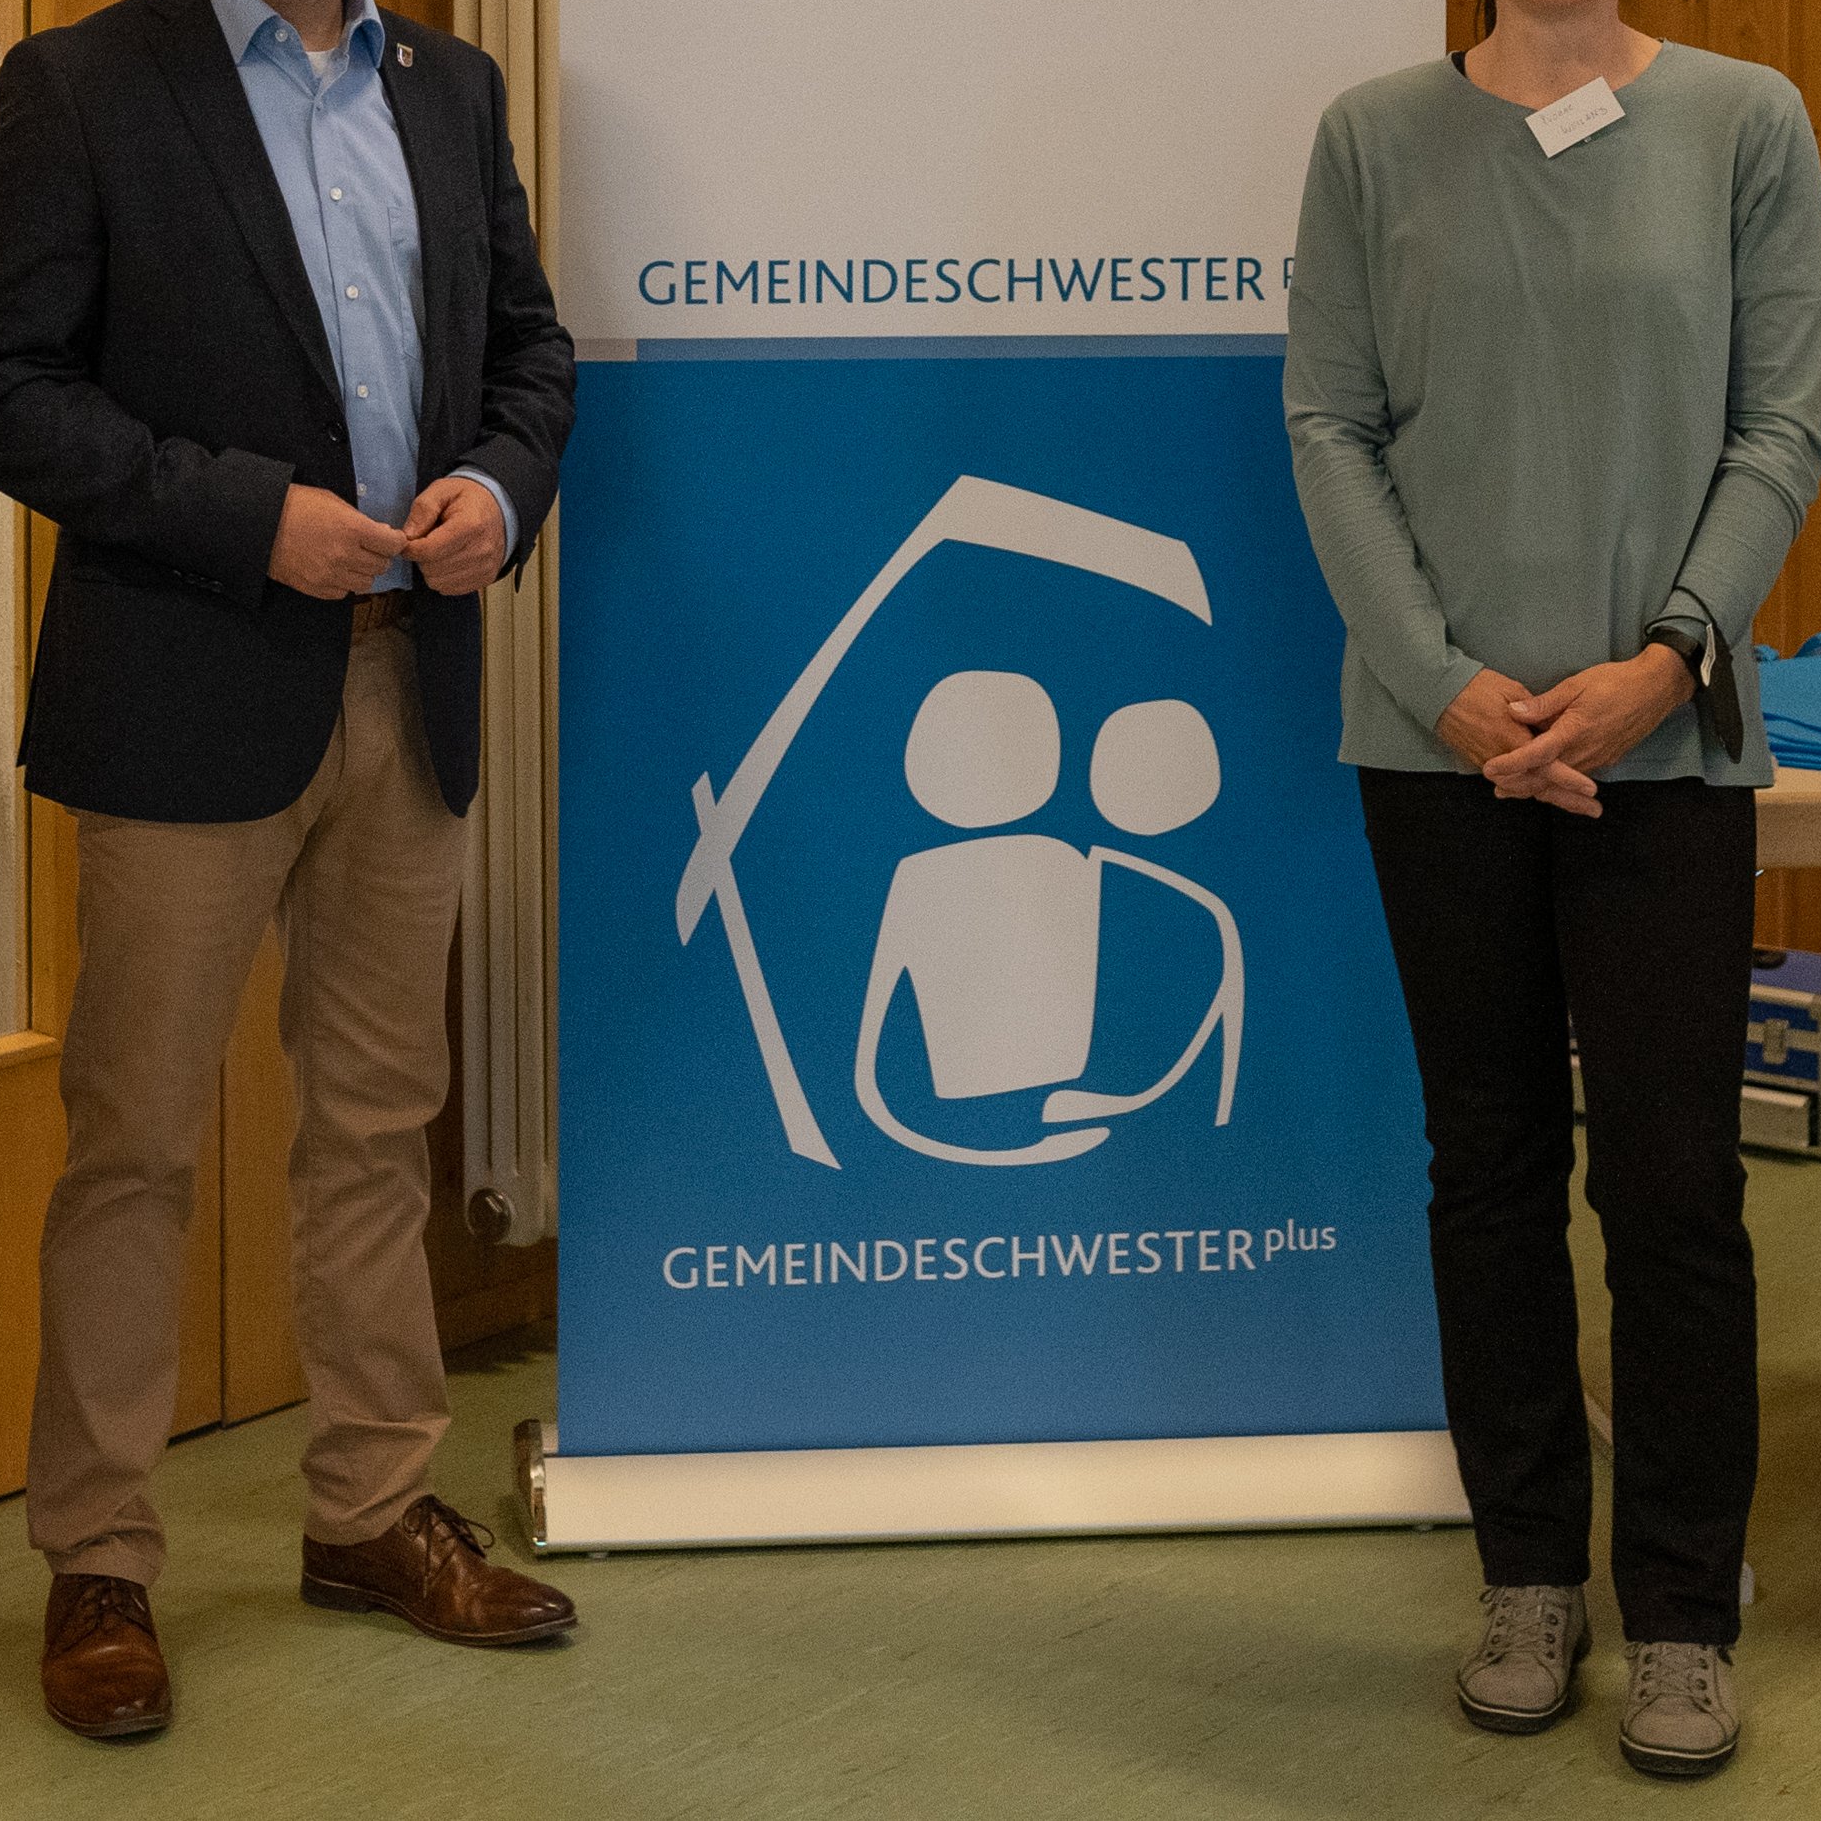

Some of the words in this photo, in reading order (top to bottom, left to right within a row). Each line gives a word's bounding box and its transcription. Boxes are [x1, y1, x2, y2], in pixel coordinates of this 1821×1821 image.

[639, 258, 1265, 307] GEMEINDESCHWESTER
[663, 1229, 1256, 1289] GEMEINDESCHWESTER
[1264, 1219, 1337, 1262] plus
